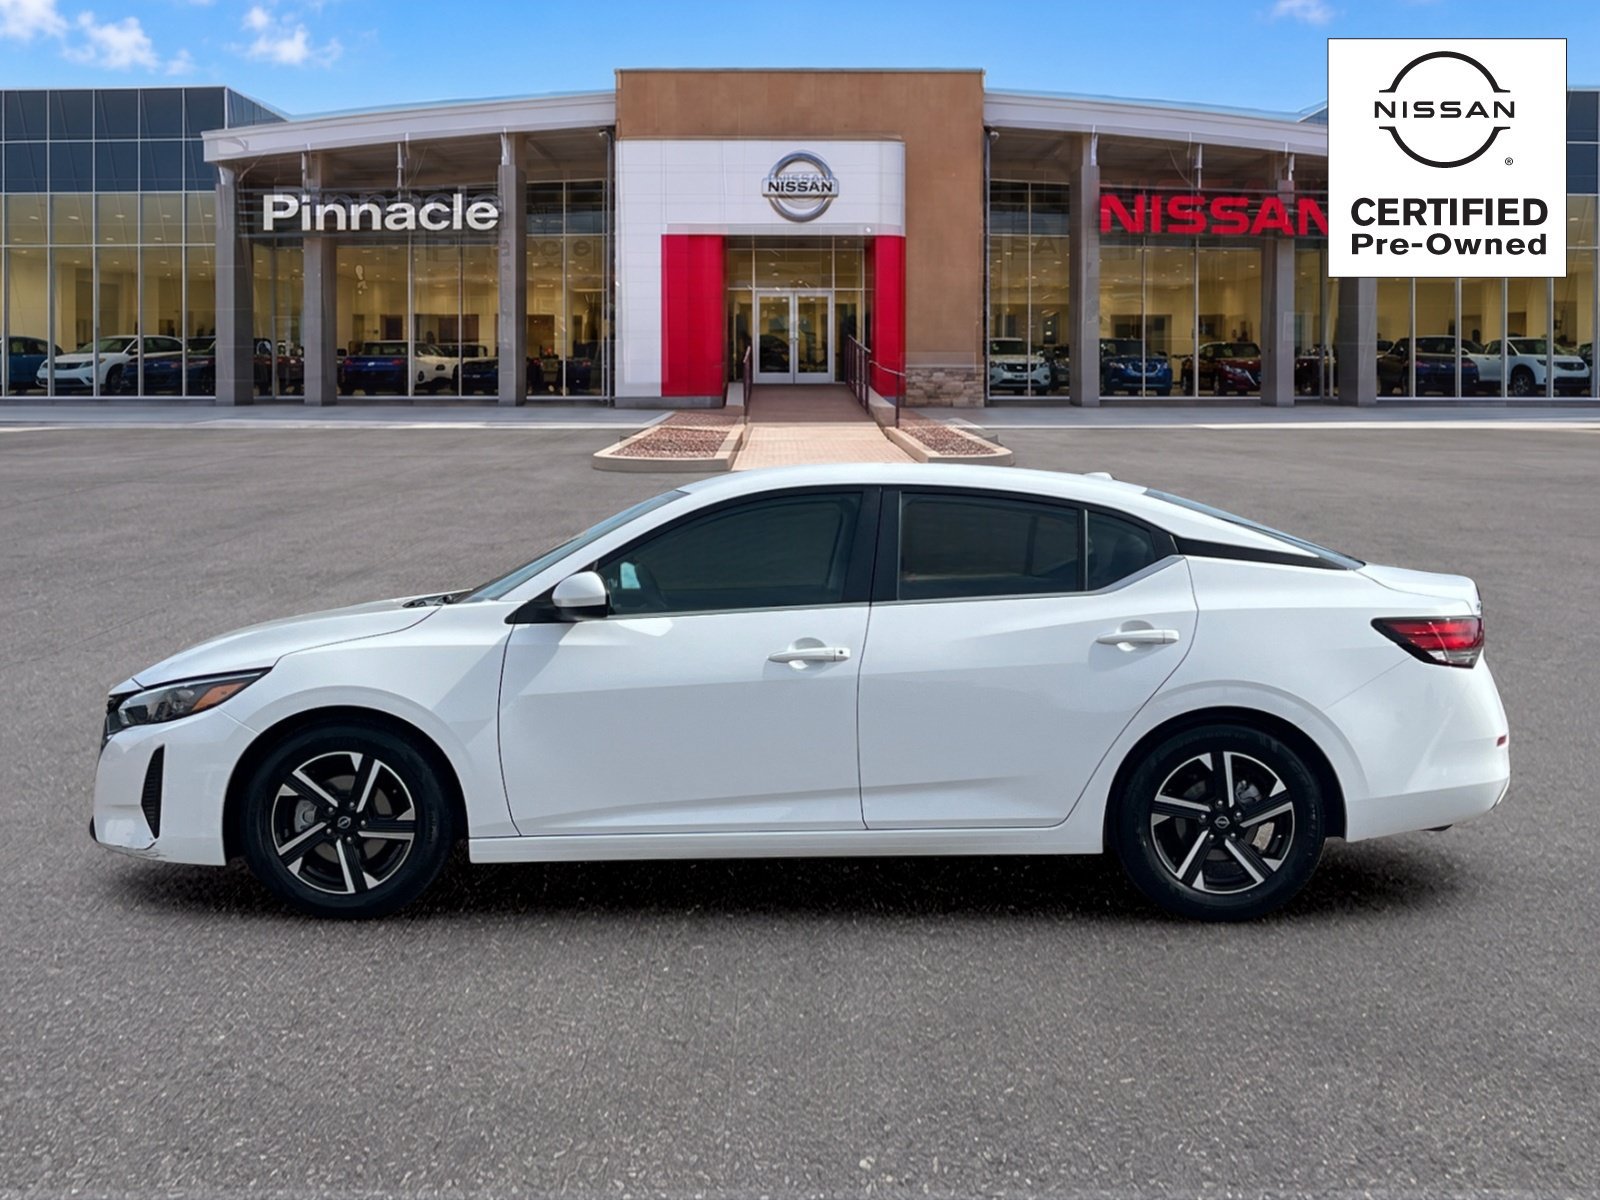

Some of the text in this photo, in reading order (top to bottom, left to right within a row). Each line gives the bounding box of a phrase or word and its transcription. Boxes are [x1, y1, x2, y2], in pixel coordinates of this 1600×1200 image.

[768, 181, 833, 193] NISSAN
[263, 193, 499, 231] Pinnacle
[1100, 194, 1328, 236] NISSAN
